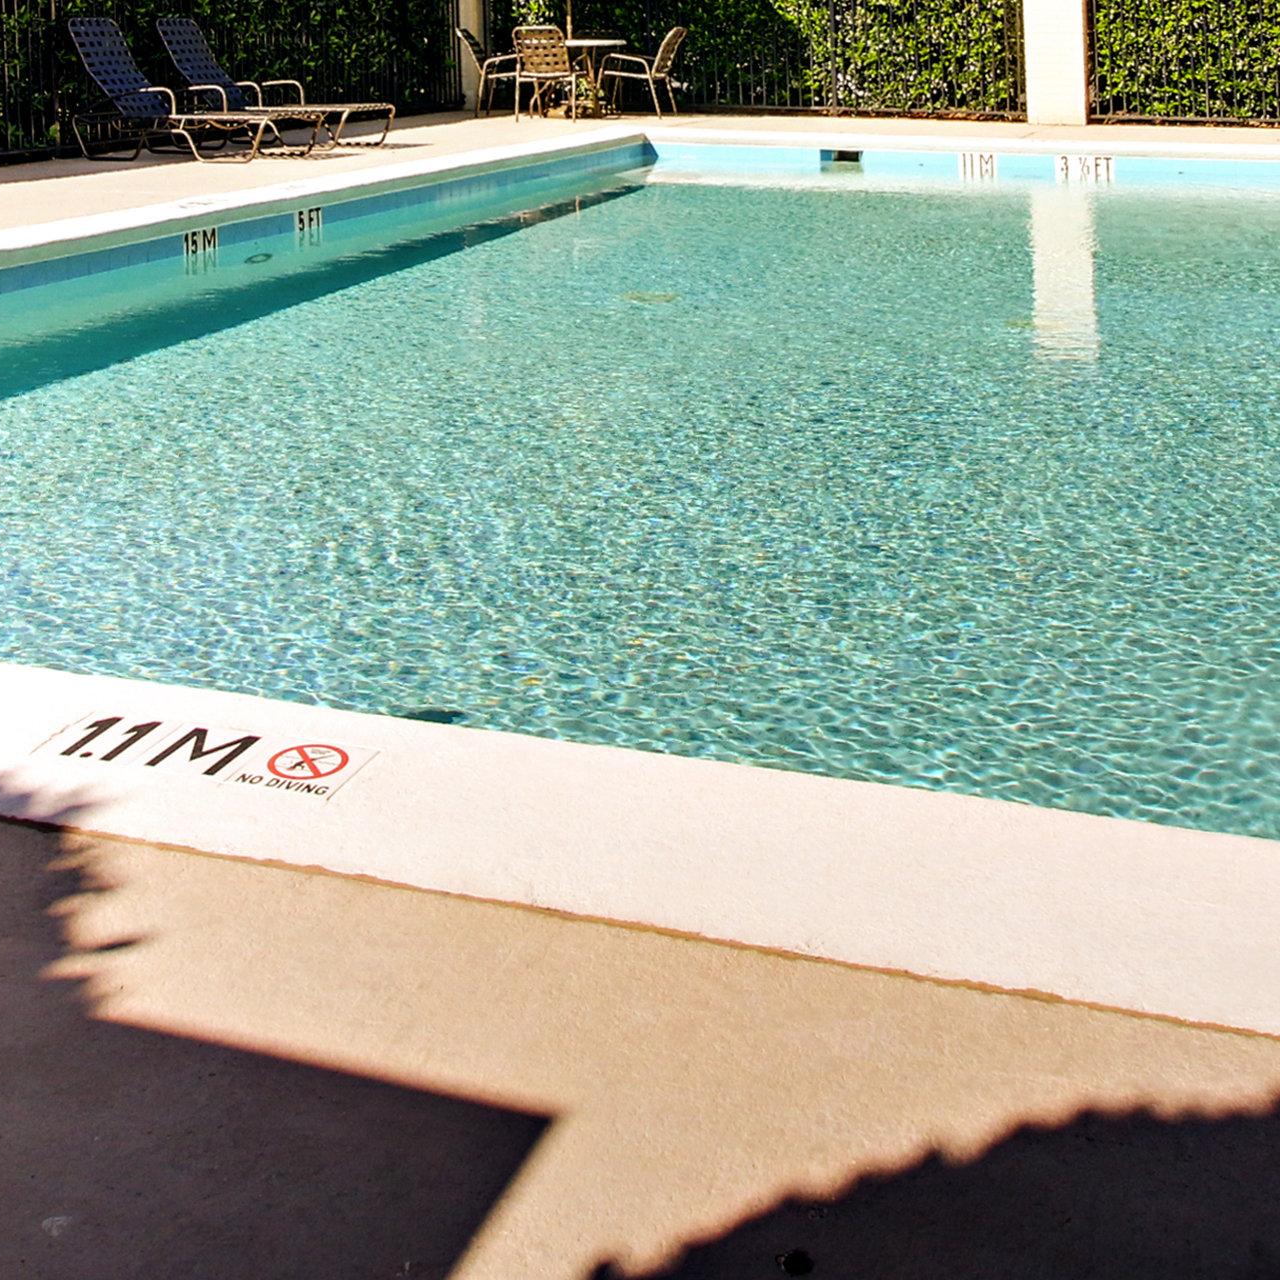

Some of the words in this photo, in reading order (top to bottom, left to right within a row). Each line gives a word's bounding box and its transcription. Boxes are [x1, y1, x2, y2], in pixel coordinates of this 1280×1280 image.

[298, 210, 305, 231] 5
[308, 207, 322, 228] FT
[202, 227, 216, 251] M
[59, 716, 163, 762] 1.1
[145, 727, 262, 776] M
[236, 773, 264, 785] NO
[265, 776, 329, 796] DIVING
